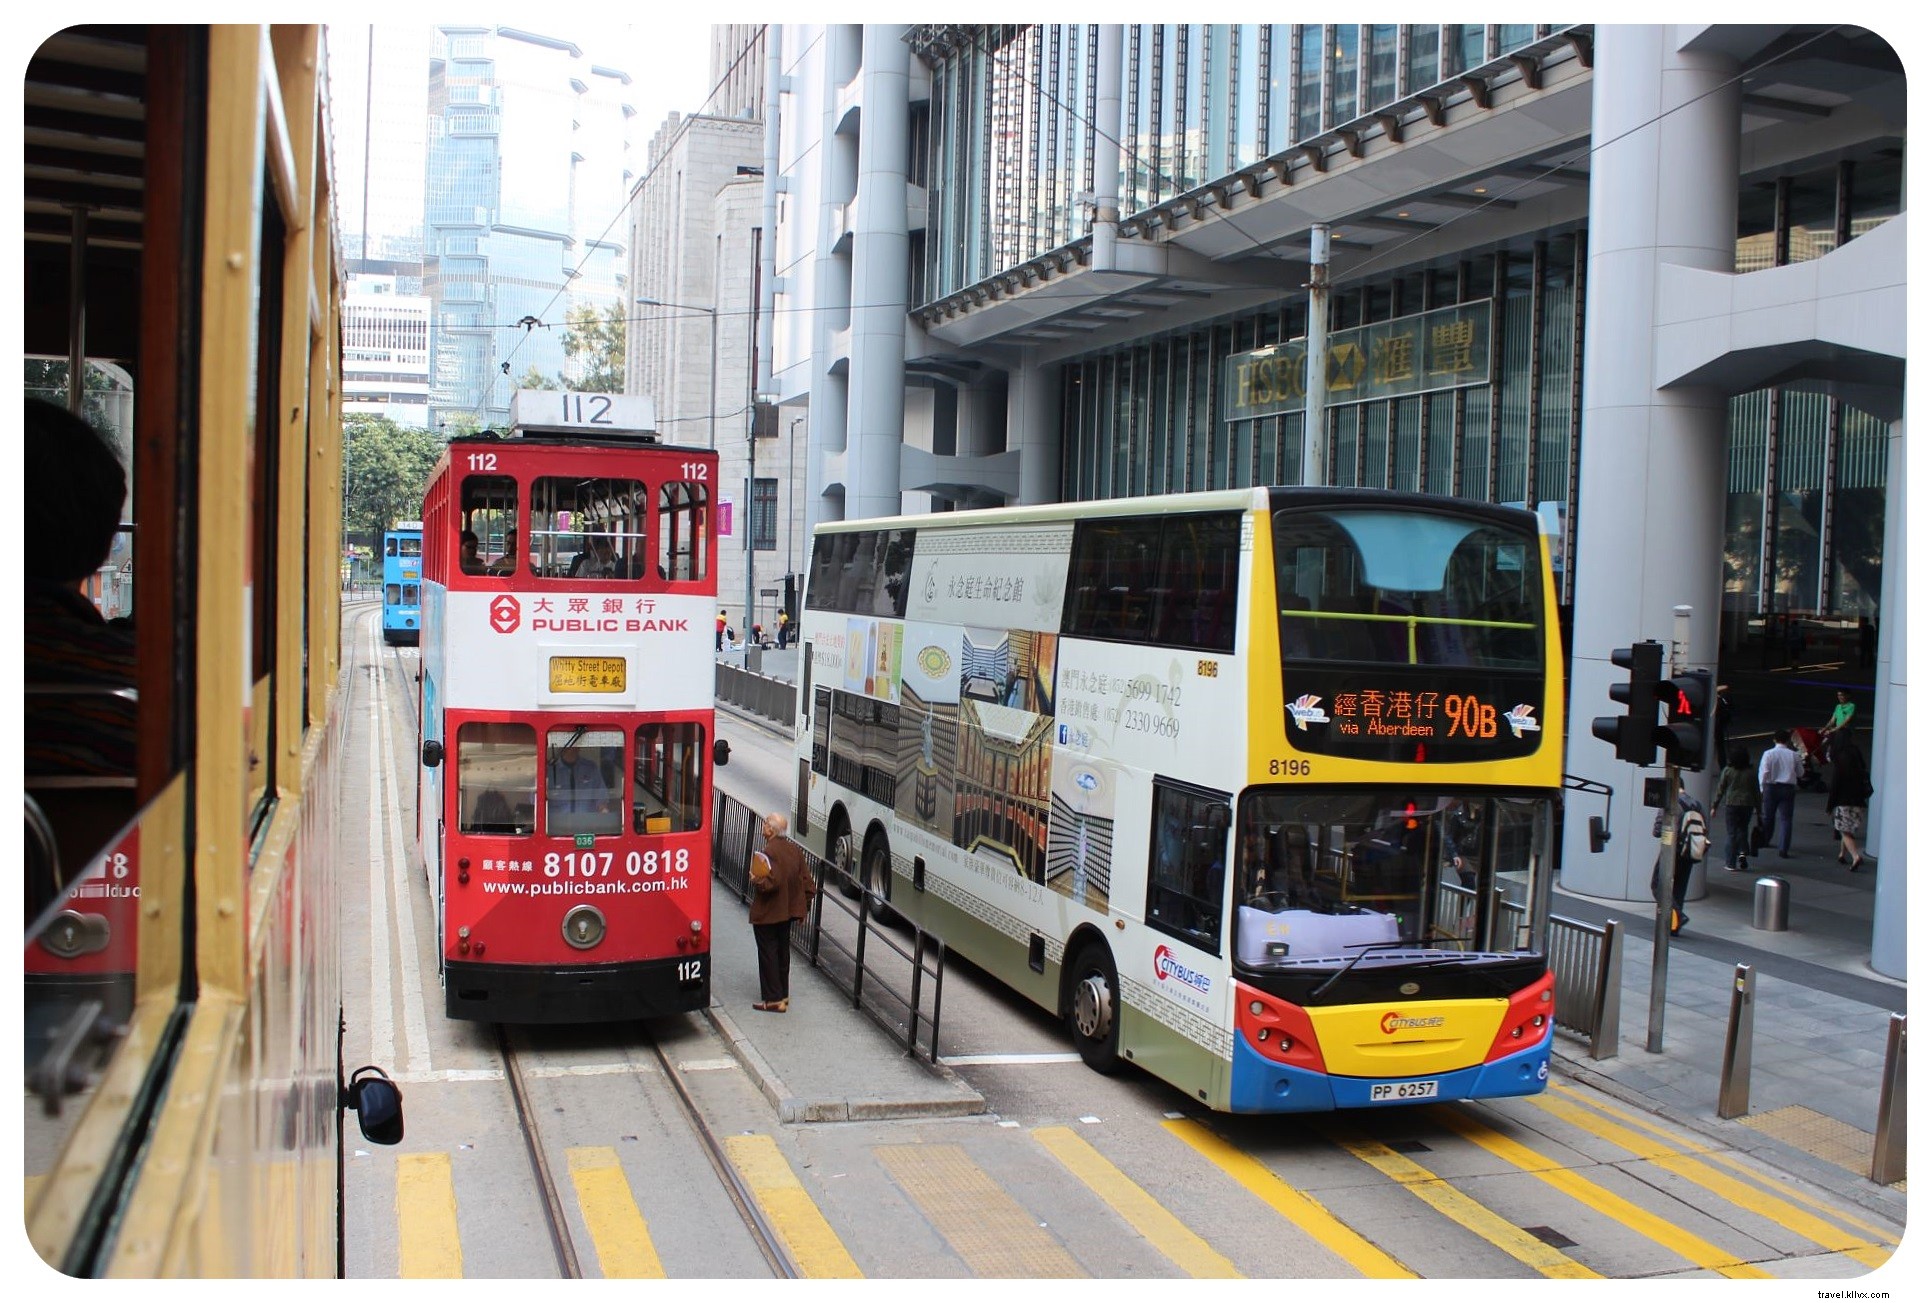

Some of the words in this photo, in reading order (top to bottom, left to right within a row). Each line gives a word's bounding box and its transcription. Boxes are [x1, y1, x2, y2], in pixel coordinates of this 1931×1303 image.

[563, 394, 613, 425] 112
[467, 453, 497, 471] 112
[681, 462, 708, 480] 112
[532, 619, 618, 632] PUBLIC
[626, 619, 689, 632] BANK
[552, 659, 576, 674] Whitty
[578, 659, 600, 673] Street
[602, 660, 624, 674] Depot
[1197, 659, 1219, 678] 8196
[1125, 679, 1151, 701] 5699
[1156, 683, 1181, 707] 1742
[1125, 709, 1150, 733] 2330
[1153, 714, 1180, 739] 9669
[1334, 690, 1439, 720] 經香港仔
[1444, 694, 1498, 738] 90B
[1340, 719, 1359, 734] via
[1367, 717, 1433, 737] Aberdeen
[1269, 760, 1310, 776] 8196
[544, 852, 613, 878] 8107
[626, 848, 689, 874] 0818
[483, 877, 689, 897] www.publicbank.com.hk
[678, 960, 701, 981] 112
[1373, 1085, 1392, 1099] PP
[1398, 1082, 1435, 1097] 6257
